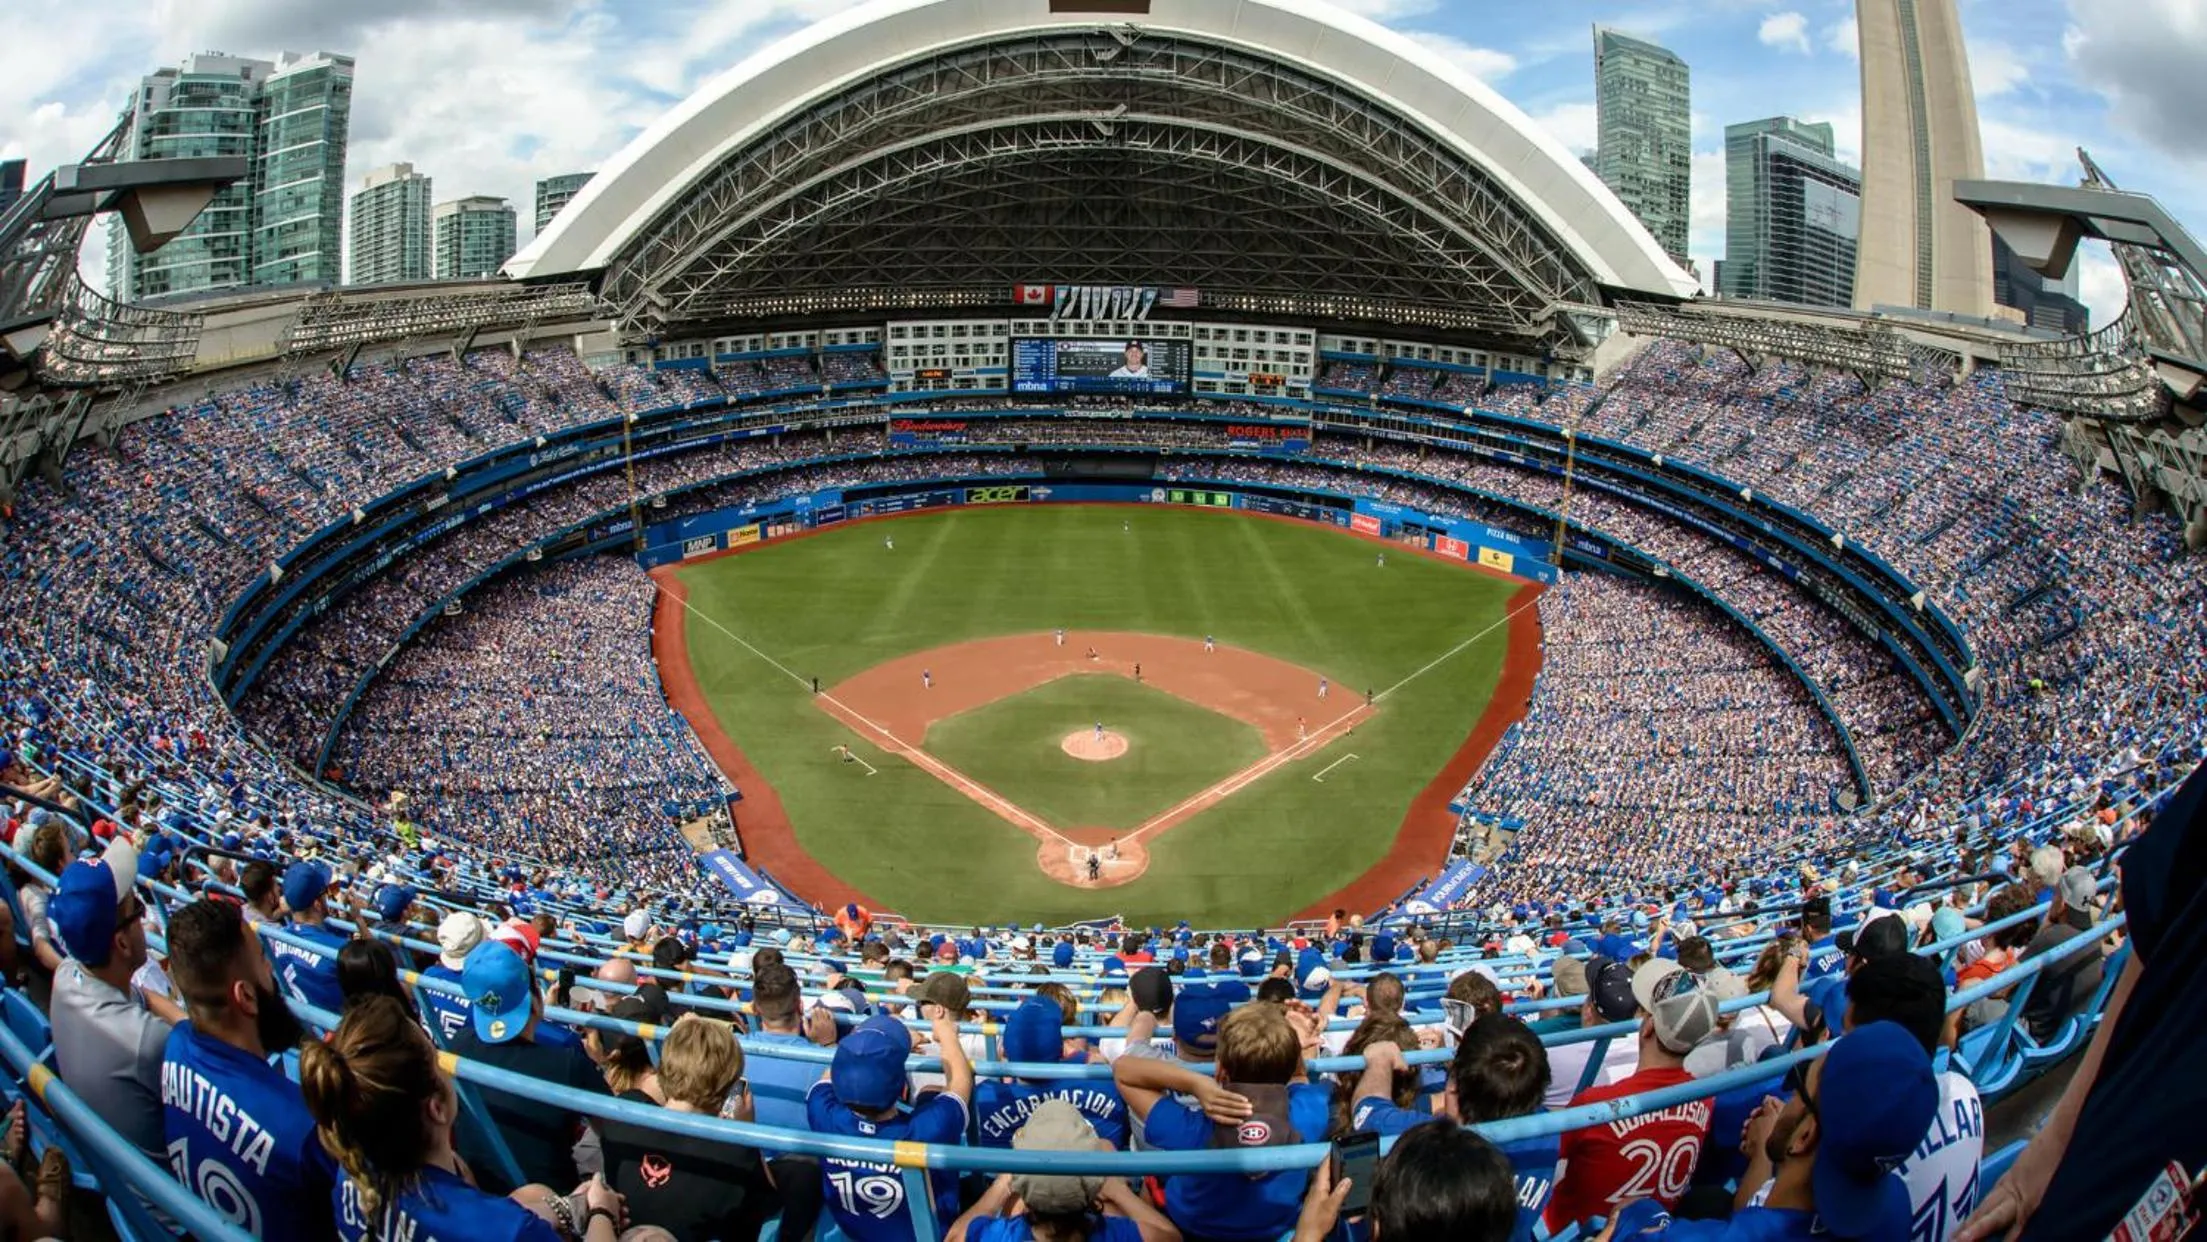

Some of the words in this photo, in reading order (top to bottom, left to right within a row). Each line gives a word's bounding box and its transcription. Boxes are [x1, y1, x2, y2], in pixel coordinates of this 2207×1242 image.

[1017, 381, 1047, 392] mbna
[1227, 425, 1276, 438] ROGERS
[970, 486, 1025, 502] acer
[687, 536, 713, 553] MNP
[1577, 540, 1602, 555] mbna
[161, 1061, 275, 1177] BAUTISTA
[1897, 1097, 1982, 1176] LLAR
[1604, 1135, 1700, 1203] 20
[827, 1171, 904, 1219] 19
